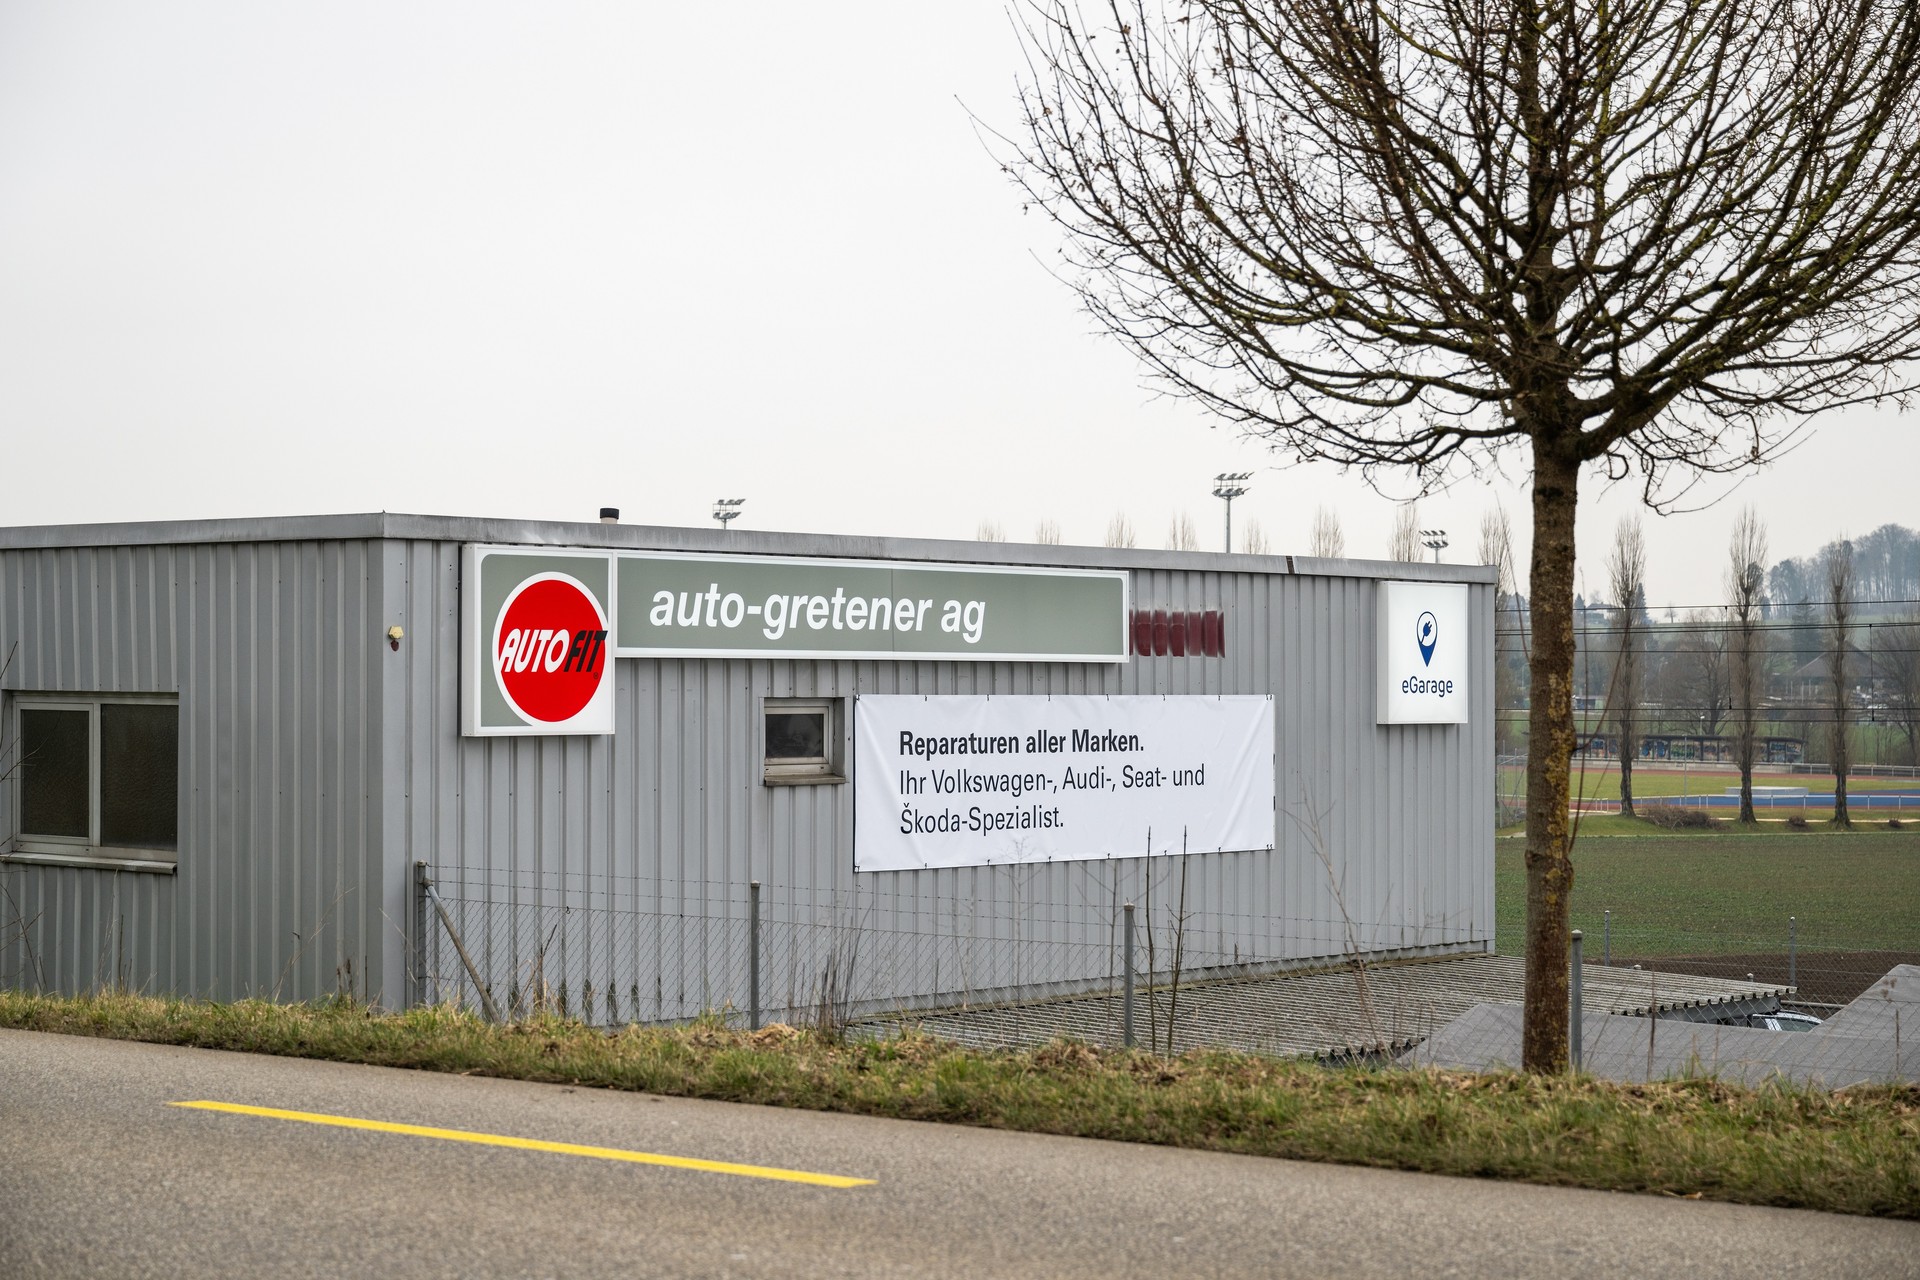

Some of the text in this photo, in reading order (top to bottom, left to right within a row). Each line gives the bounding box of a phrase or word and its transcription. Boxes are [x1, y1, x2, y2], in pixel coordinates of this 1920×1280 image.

[649, 583, 986, 644] auto-gretener ag
[1401, 675, 1454, 698] eGarage
[900, 728, 1145, 761] Reparaturen aller Marken.
[900, 763, 1205, 798] Ihr Volkswagen-, Audi-, Seat- und
[900, 802, 1065, 835] Škoda-Spezialist.
